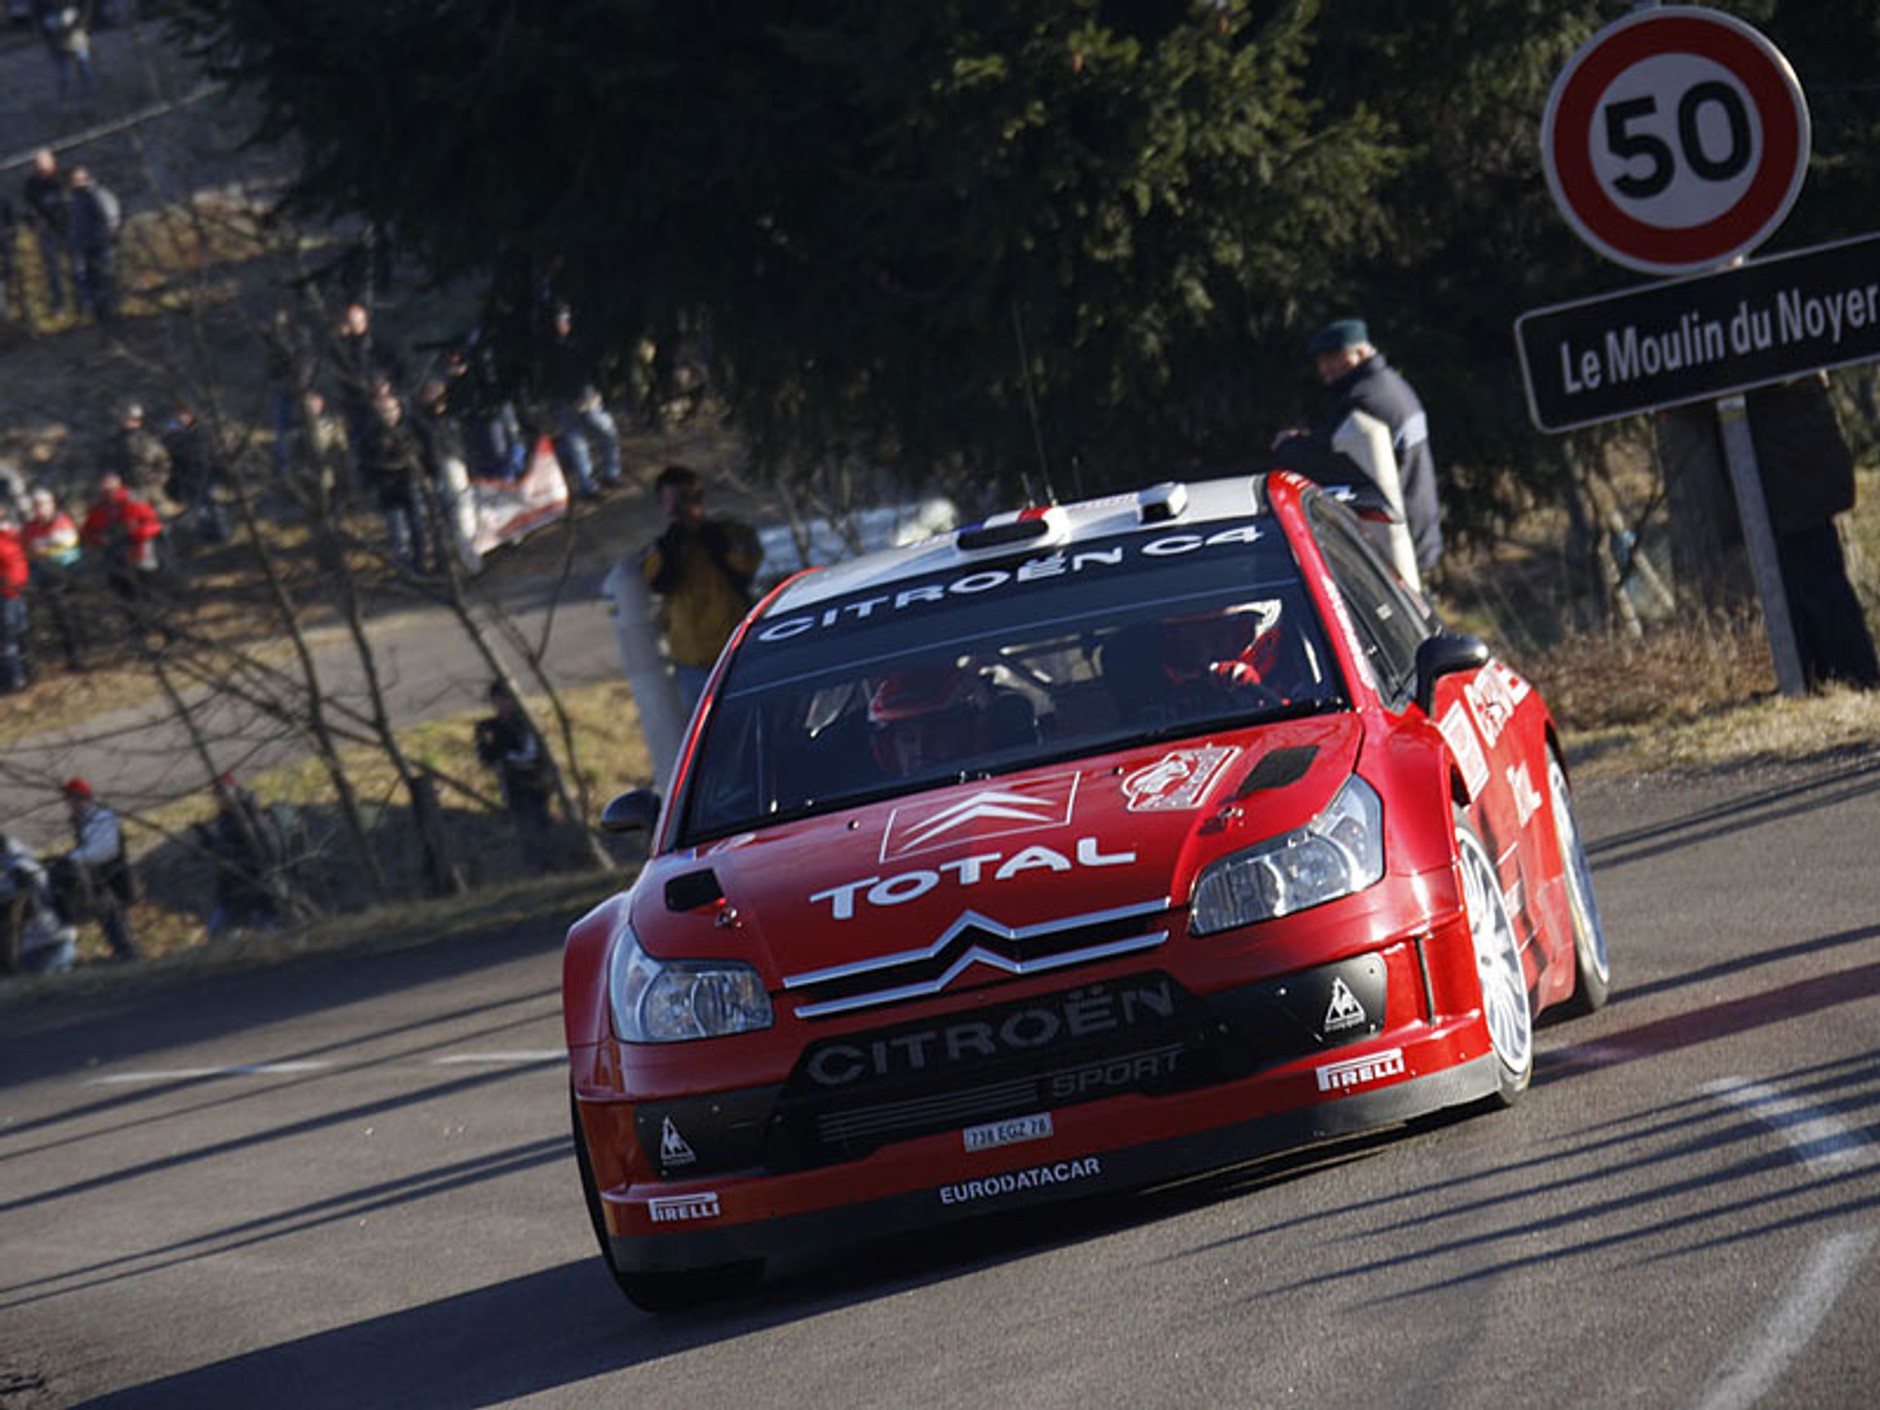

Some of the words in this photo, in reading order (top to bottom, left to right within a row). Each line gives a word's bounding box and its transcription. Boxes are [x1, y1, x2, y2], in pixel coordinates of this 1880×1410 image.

[1605, 80, 1752, 199] 50
[1561, 340, 1601, 394] Le
[1605, 312, 1725, 385] Moulin
[1731, 302, 1773, 355] du
[1778, 284, 1880, 344] Noyer
[758, 547, 1124, 643] CITROËN
[1141, 526, 1264, 555] C4
[809, 838, 1136, 920] TOTAL
[807, 980, 1175, 1086] CITROËN
[1050, 1050, 1184, 1098] SPORT
[1316, 1048, 1405, 1091] PIRELLI
[648, 1191, 720, 1222] PIRELLI
[940, 1157, 1101, 1206] EURODATACAR
